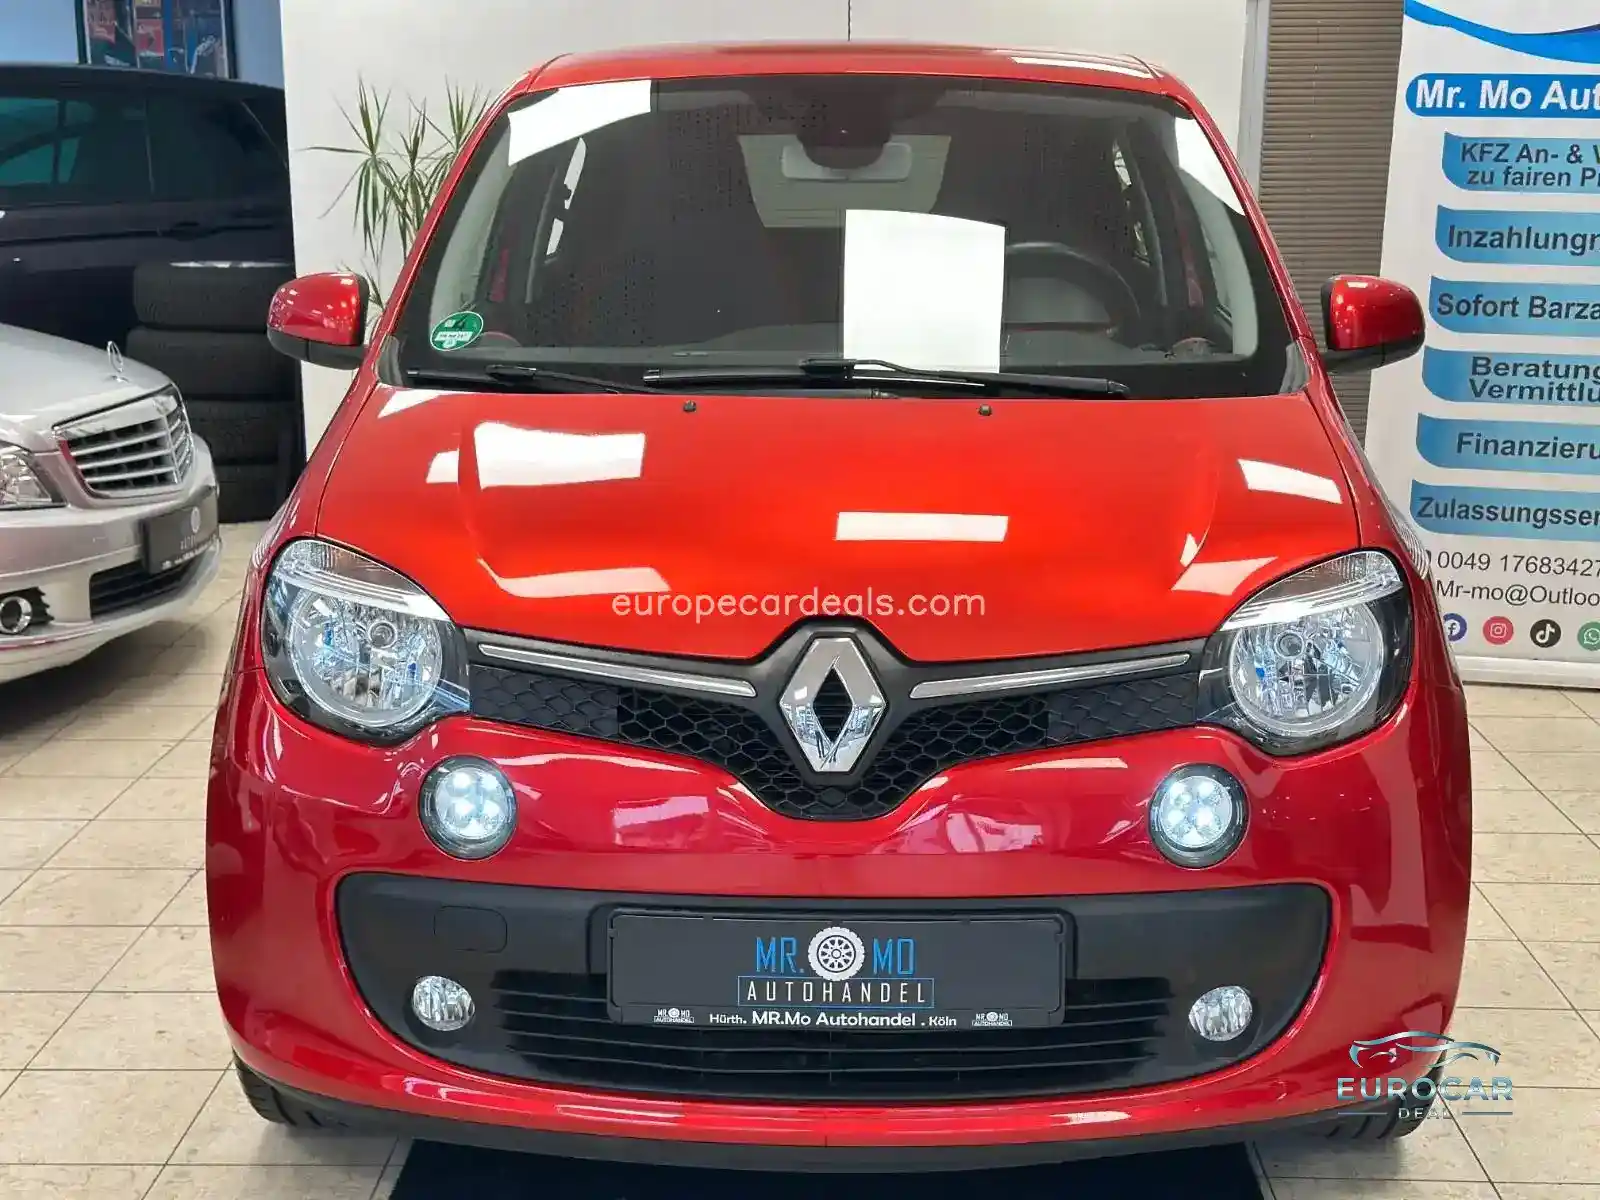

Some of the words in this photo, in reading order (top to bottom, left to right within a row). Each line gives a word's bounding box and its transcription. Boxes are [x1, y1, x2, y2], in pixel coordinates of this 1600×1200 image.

[1416, 79, 1466, 110] Mr.
[1479, 80, 1532, 110] Mo
[1460, 142, 1509, 163] KFZ
[1515, 143, 1559, 164] An-
[1566, 143, 1583, 165] &
[1467, 168, 1494, 186] zu
[1502, 166, 1572, 187] fairen
[1436, 292, 1520, 317] Sofort
[1528, 295, 1600, 321] Barza
[1468, 378, 1600, 403] Vermittlu
[1456, 432, 1600, 461] Finanzieru
[1437, 550, 1491, 571] 0049
[755, 936, 805, 974] MR.
[872, 937, 916, 976] MO
[746, 980, 926, 1004] AUTOHANDEL
[752, 1010, 811, 1026] MR.Mo
[816, 1011, 916, 1027] Autohandel
[928, 1015, 957, 1027] Köln
